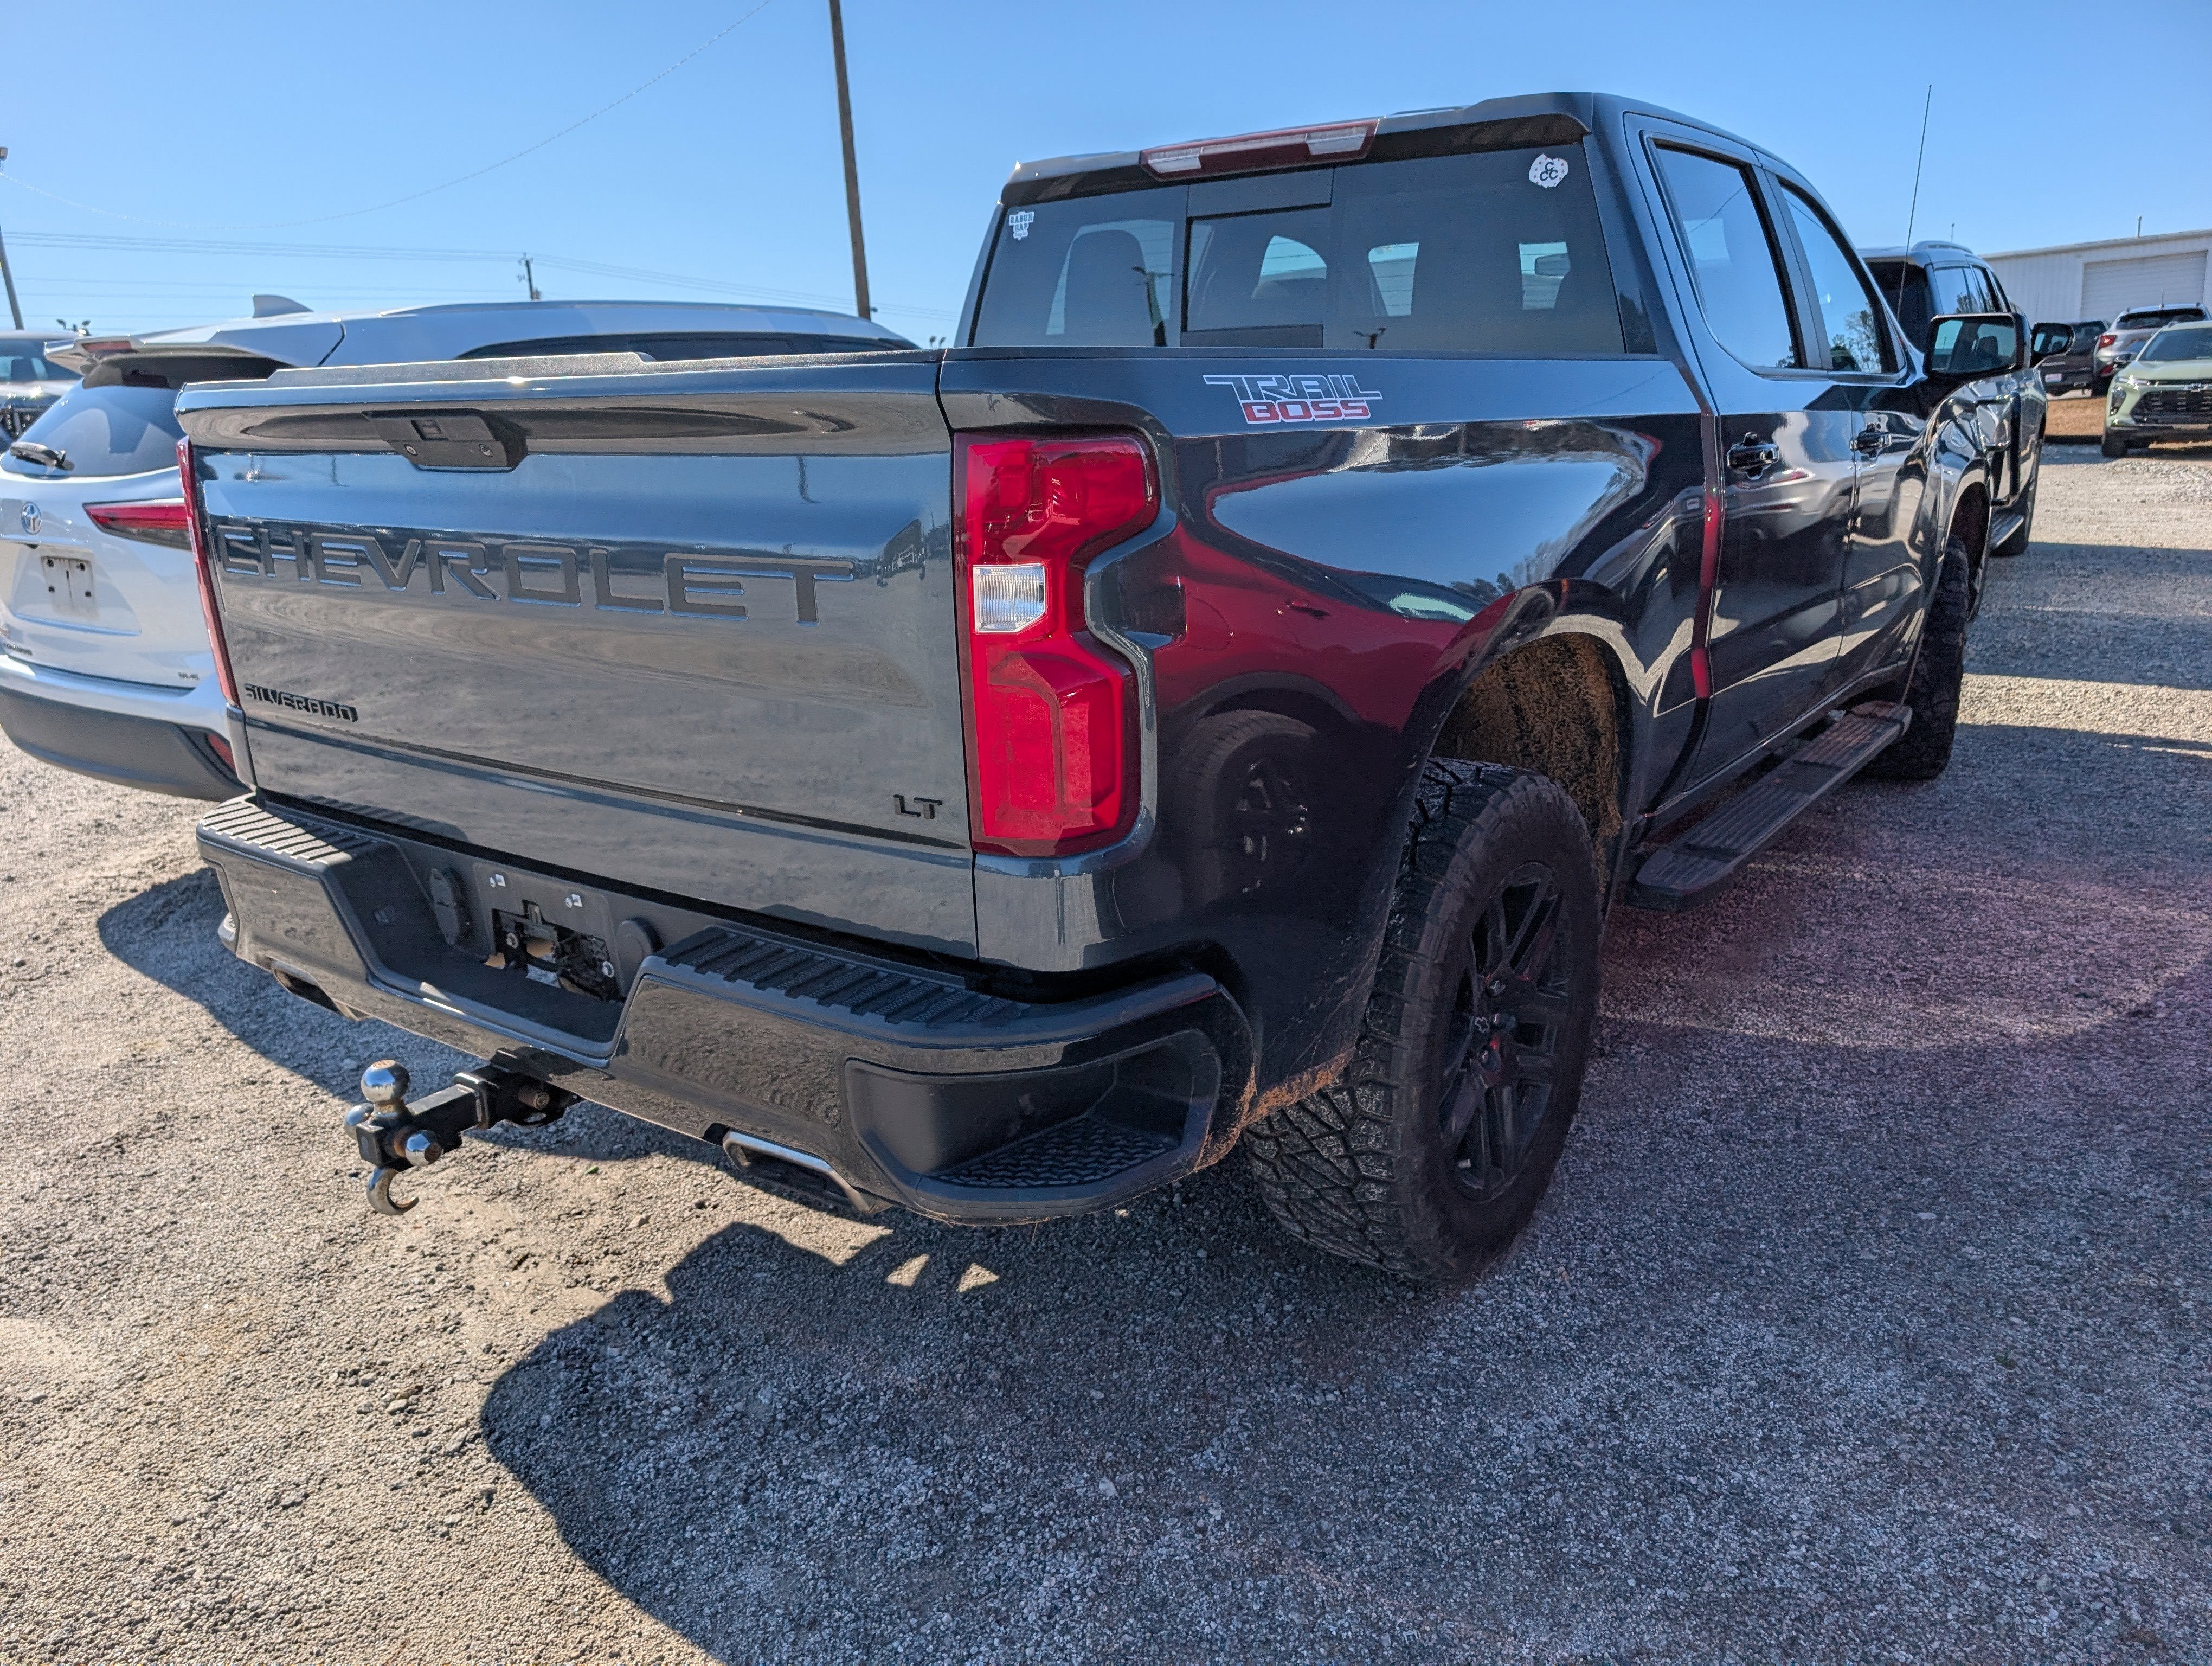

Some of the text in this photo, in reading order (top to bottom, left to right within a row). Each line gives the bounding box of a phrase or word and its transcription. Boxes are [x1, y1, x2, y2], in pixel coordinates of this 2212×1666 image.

[1010, 214, 1033, 223] RABUN
[1014, 223, 1028, 231] GAP
[1202, 374, 1384, 401] TRAIL
[1242, 399, 1371, 424] BOSS
[217, 524, 854, 626] CHEVROLET
[245, 683, 359, 722] SILVERADO
[893, 794, 943, 820] LT
